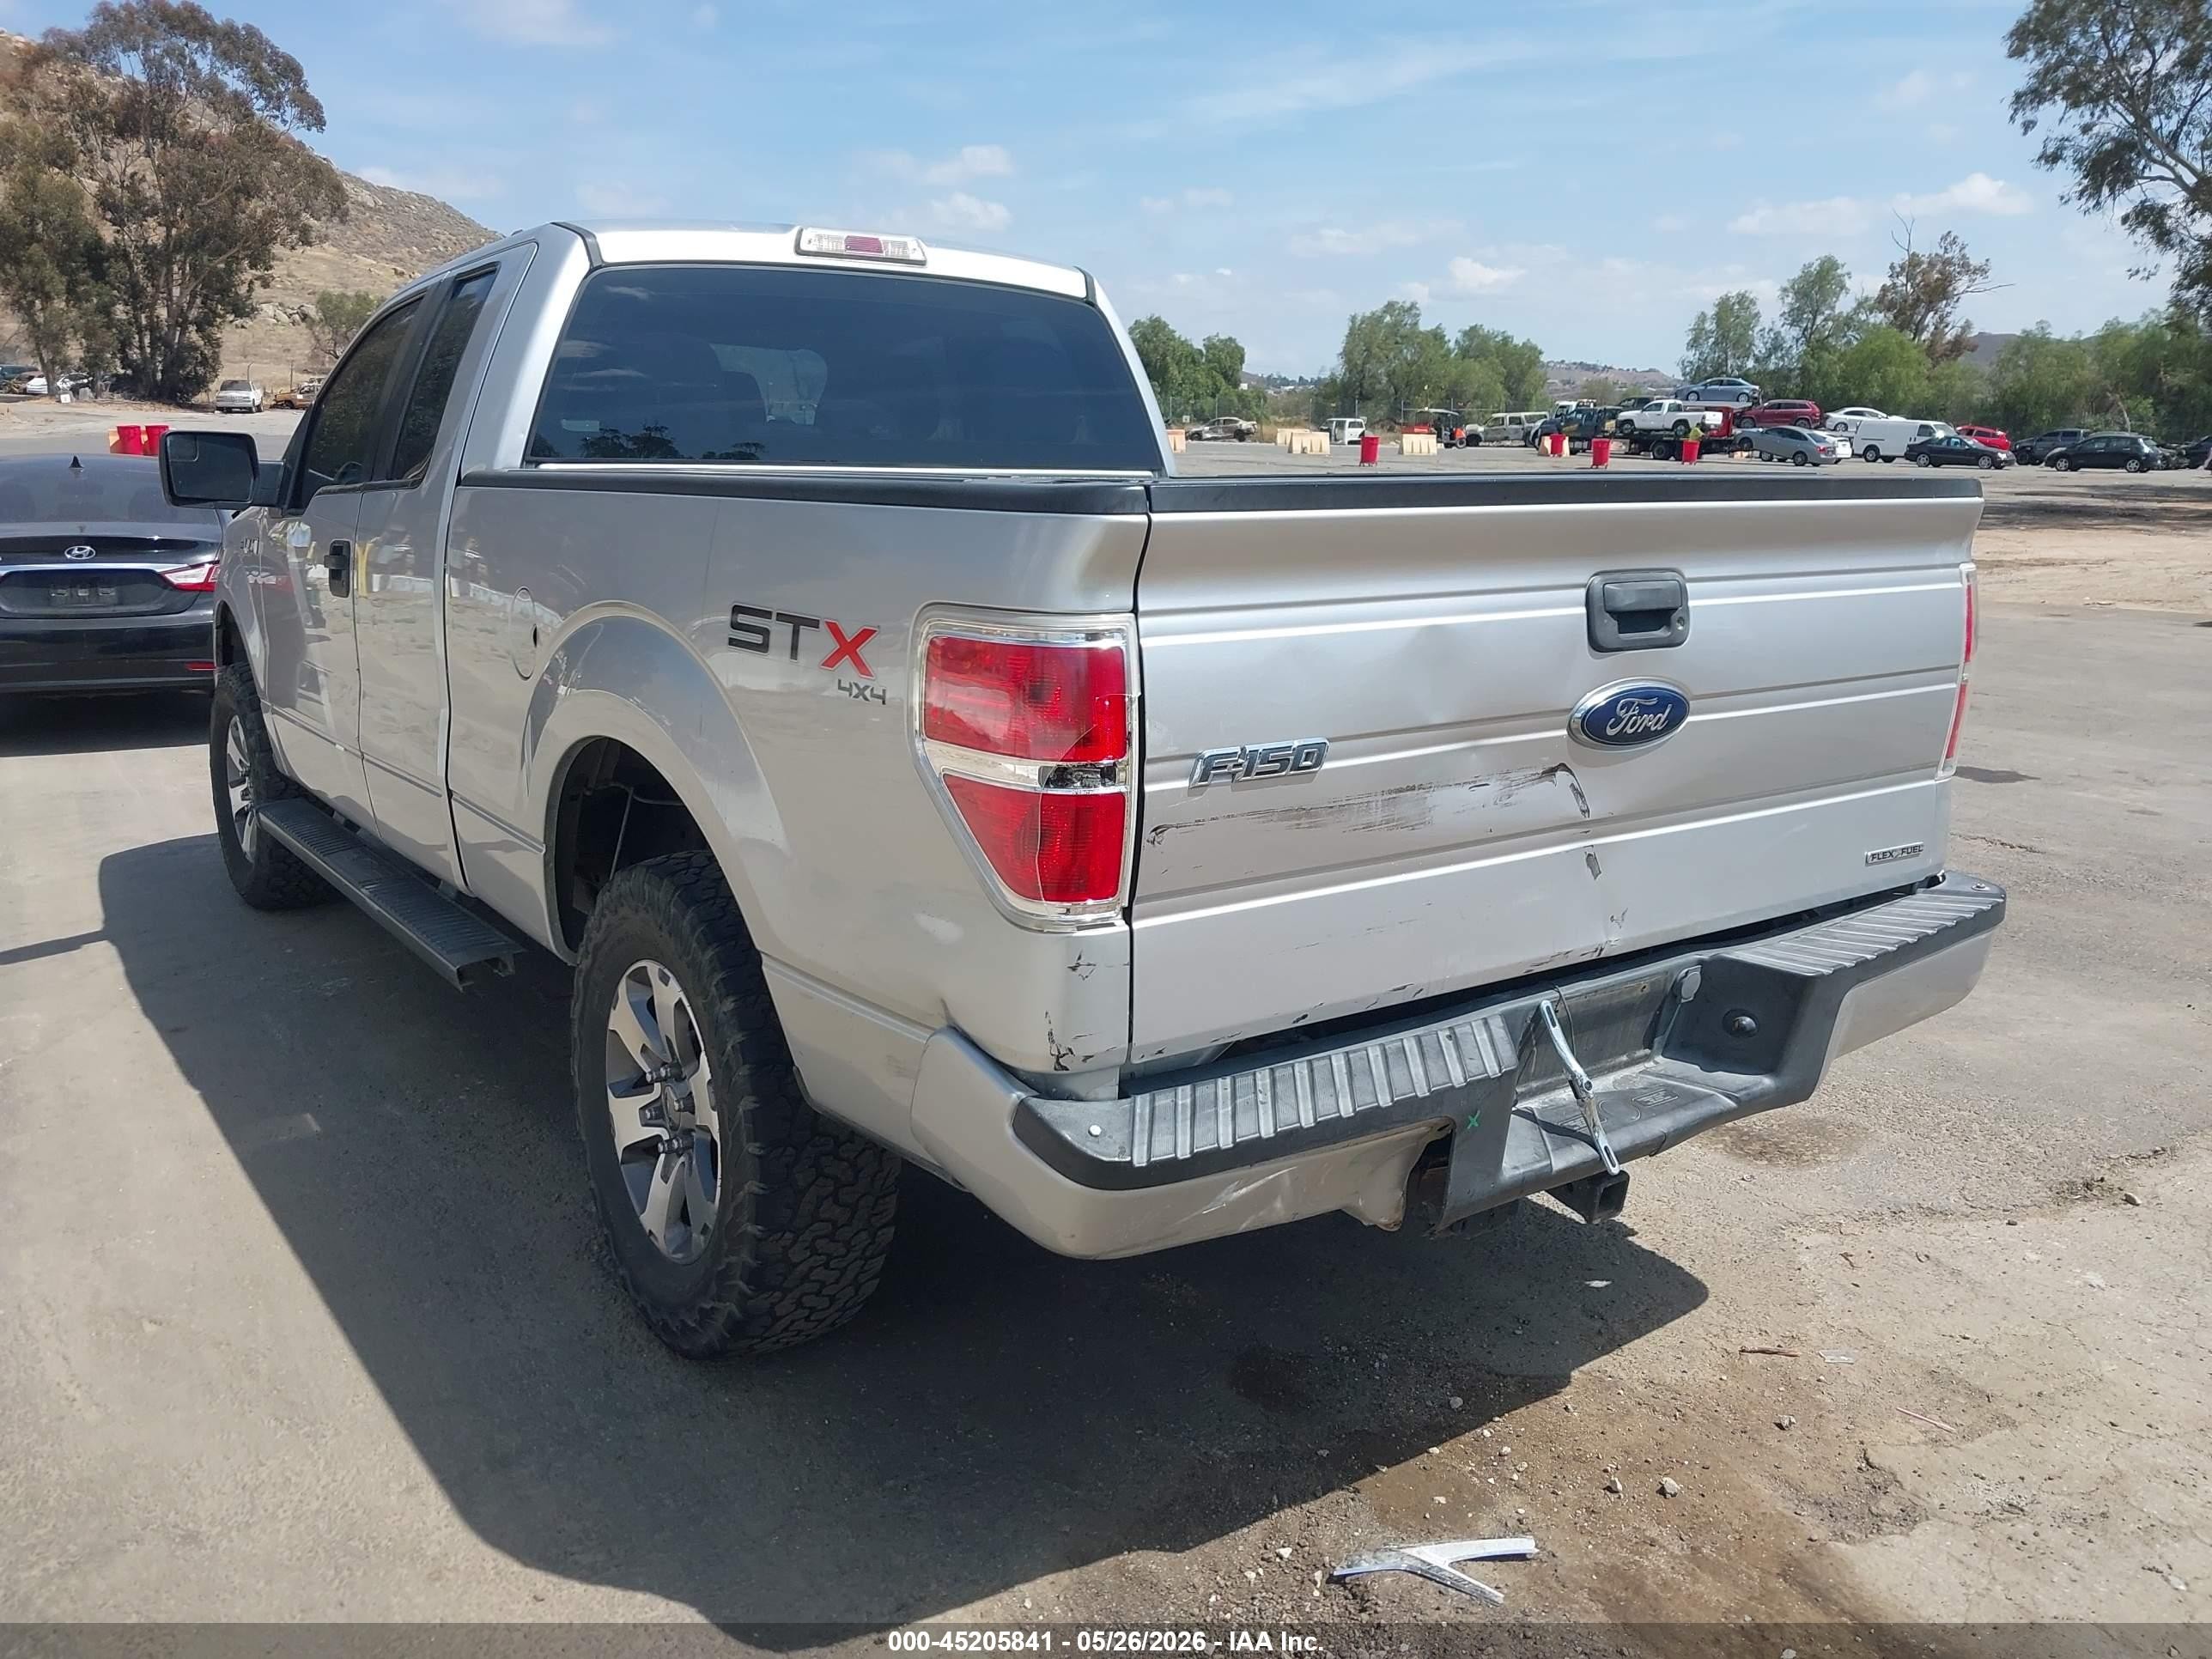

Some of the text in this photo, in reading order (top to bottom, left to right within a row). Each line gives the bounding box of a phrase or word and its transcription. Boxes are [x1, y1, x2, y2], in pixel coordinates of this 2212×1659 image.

[728, 603, 879, 679] STX
[1606, 696, 1673, 736] Ford
[1188, 737, 1330, 788] F-150
[1870, 844, 1924, 861] FLEX FUEL
